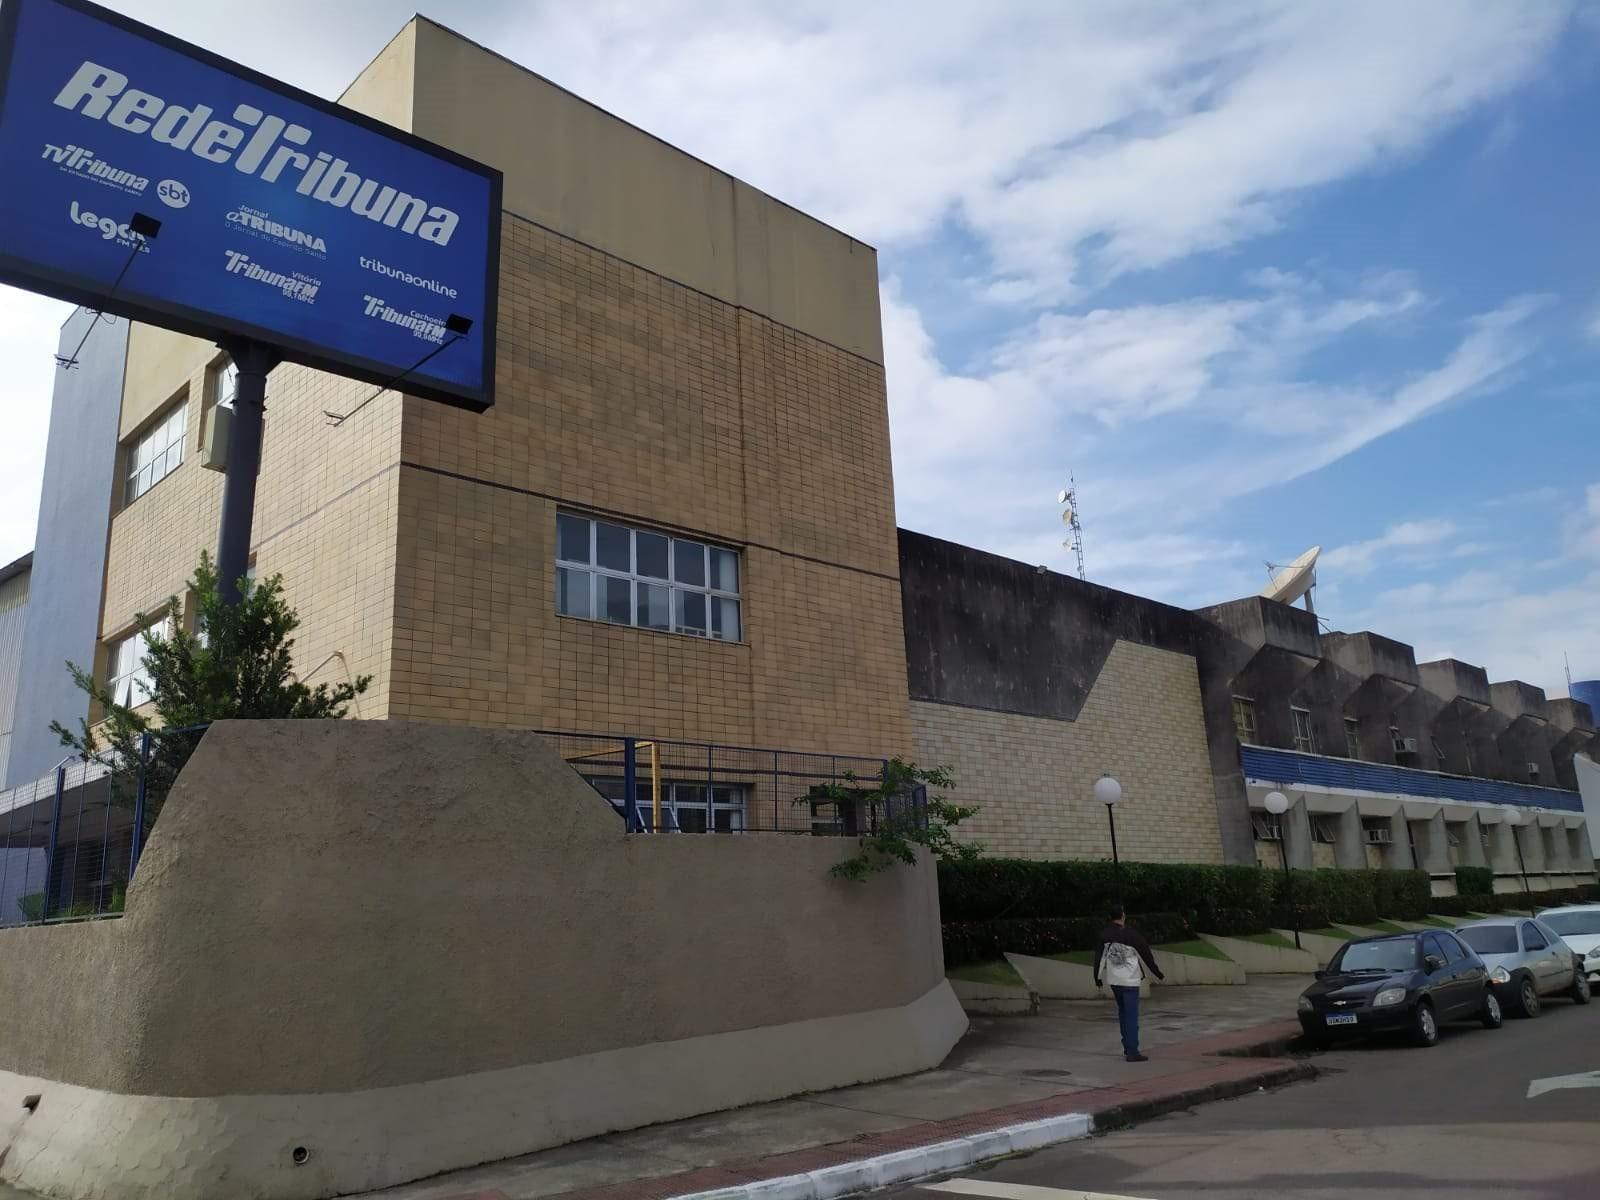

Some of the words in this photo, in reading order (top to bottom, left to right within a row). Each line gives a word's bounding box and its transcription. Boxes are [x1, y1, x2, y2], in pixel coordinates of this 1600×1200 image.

[158, 183, 189, 204] sbt
[239, 205, 269, 218] Jornal
[360, 256, 458, 299] tribunaonline
